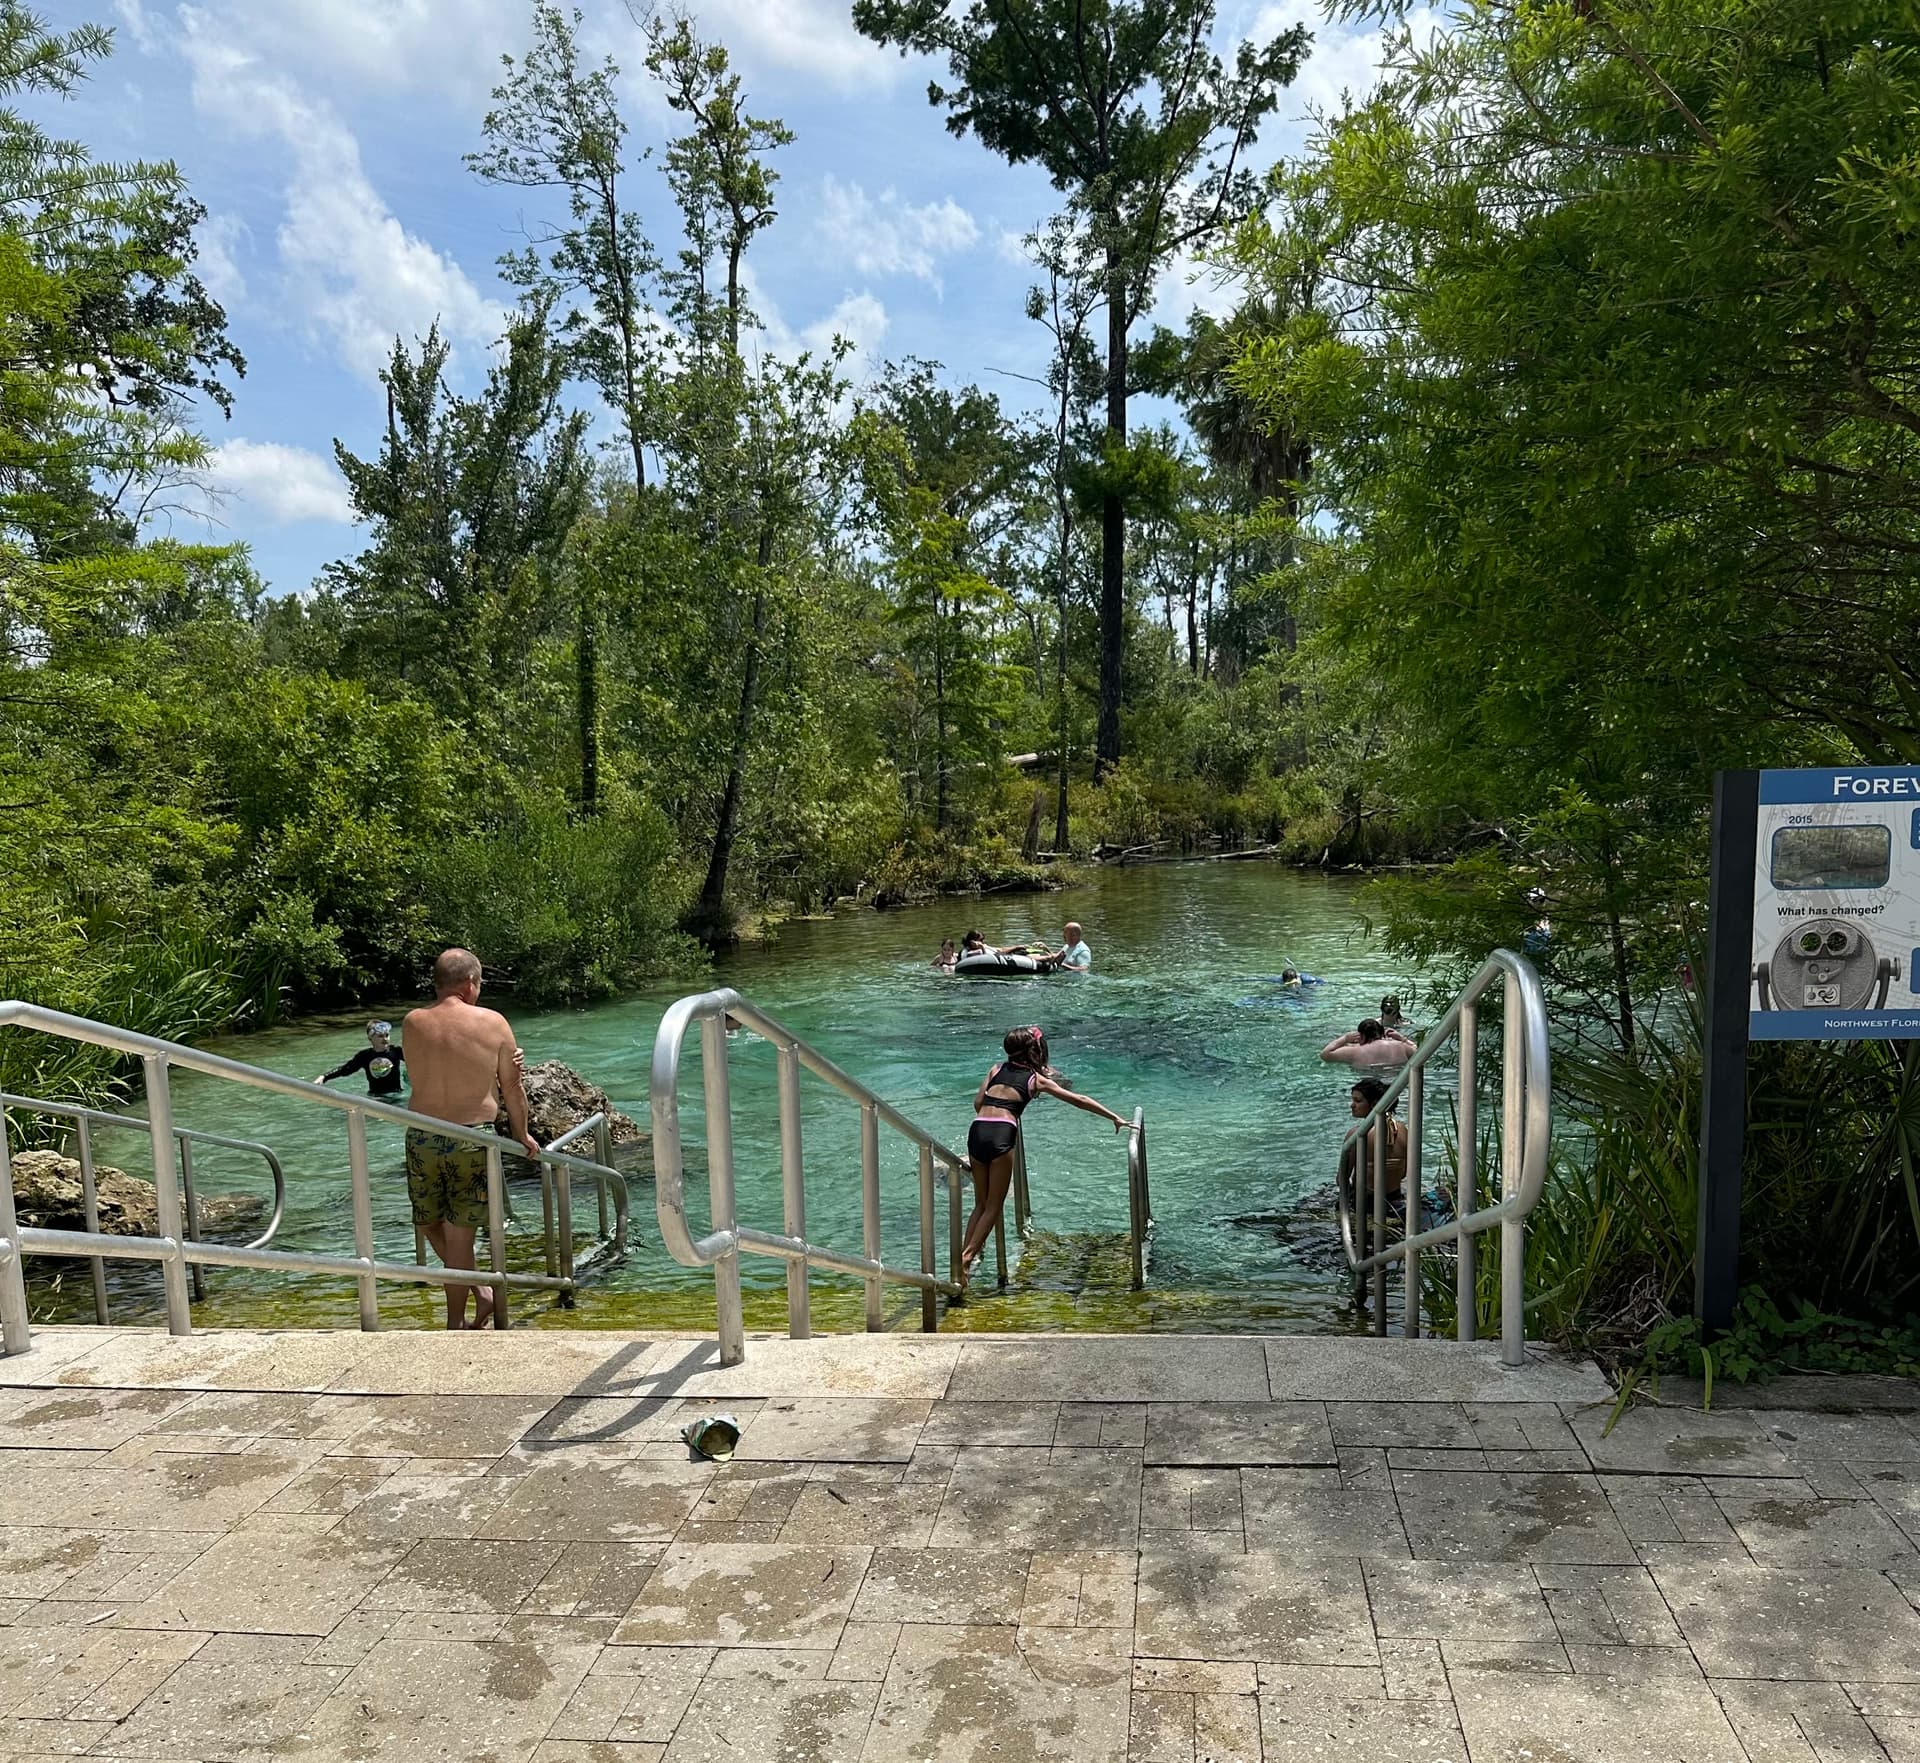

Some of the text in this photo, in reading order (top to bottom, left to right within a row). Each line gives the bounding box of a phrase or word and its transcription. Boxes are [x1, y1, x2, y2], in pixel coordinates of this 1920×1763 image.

[1788, 815, 1812, 824] 2015
[1777, 905, 1885, 917] What has changed?
[1824, 1019, 1889, 1028] NORTHWEST
